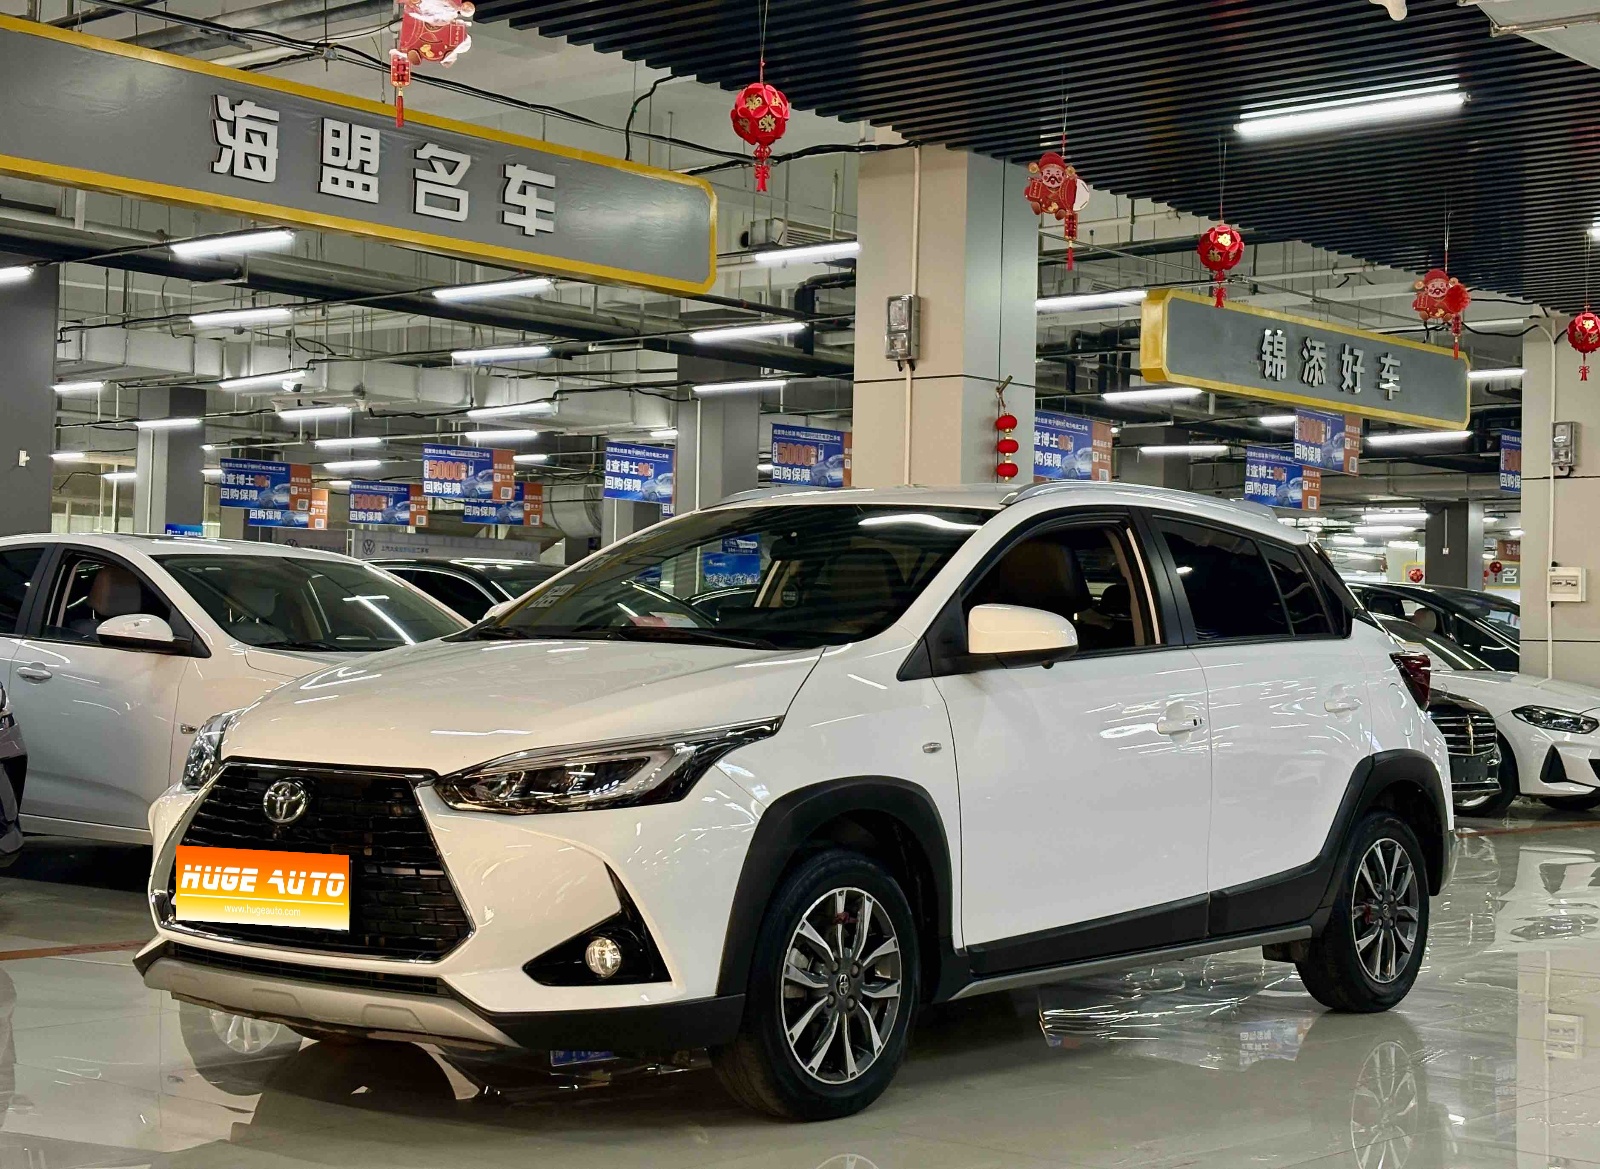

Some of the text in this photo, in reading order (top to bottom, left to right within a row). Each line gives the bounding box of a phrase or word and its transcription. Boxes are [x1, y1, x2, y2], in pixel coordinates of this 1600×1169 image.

[208, 94, 556, 236] 海盟名车
[1260, 328, 1401, 400] 锦添好车
[1294, 443, 1321, 463] 回购保障
[772, 466, 811, 482] 回购保障
[423, 481, 462, 495] 回购保障
[605, 476, 642, 492] 回购保障
[1244, 481, 1276, 497] 回购保障
[220, 487, 258, 501] 回购保障
[249, 510, 281, 520] 回购保障
[349, 511, 383, 521] 回购保障
[464, 505, 497, 517] 回购保障
